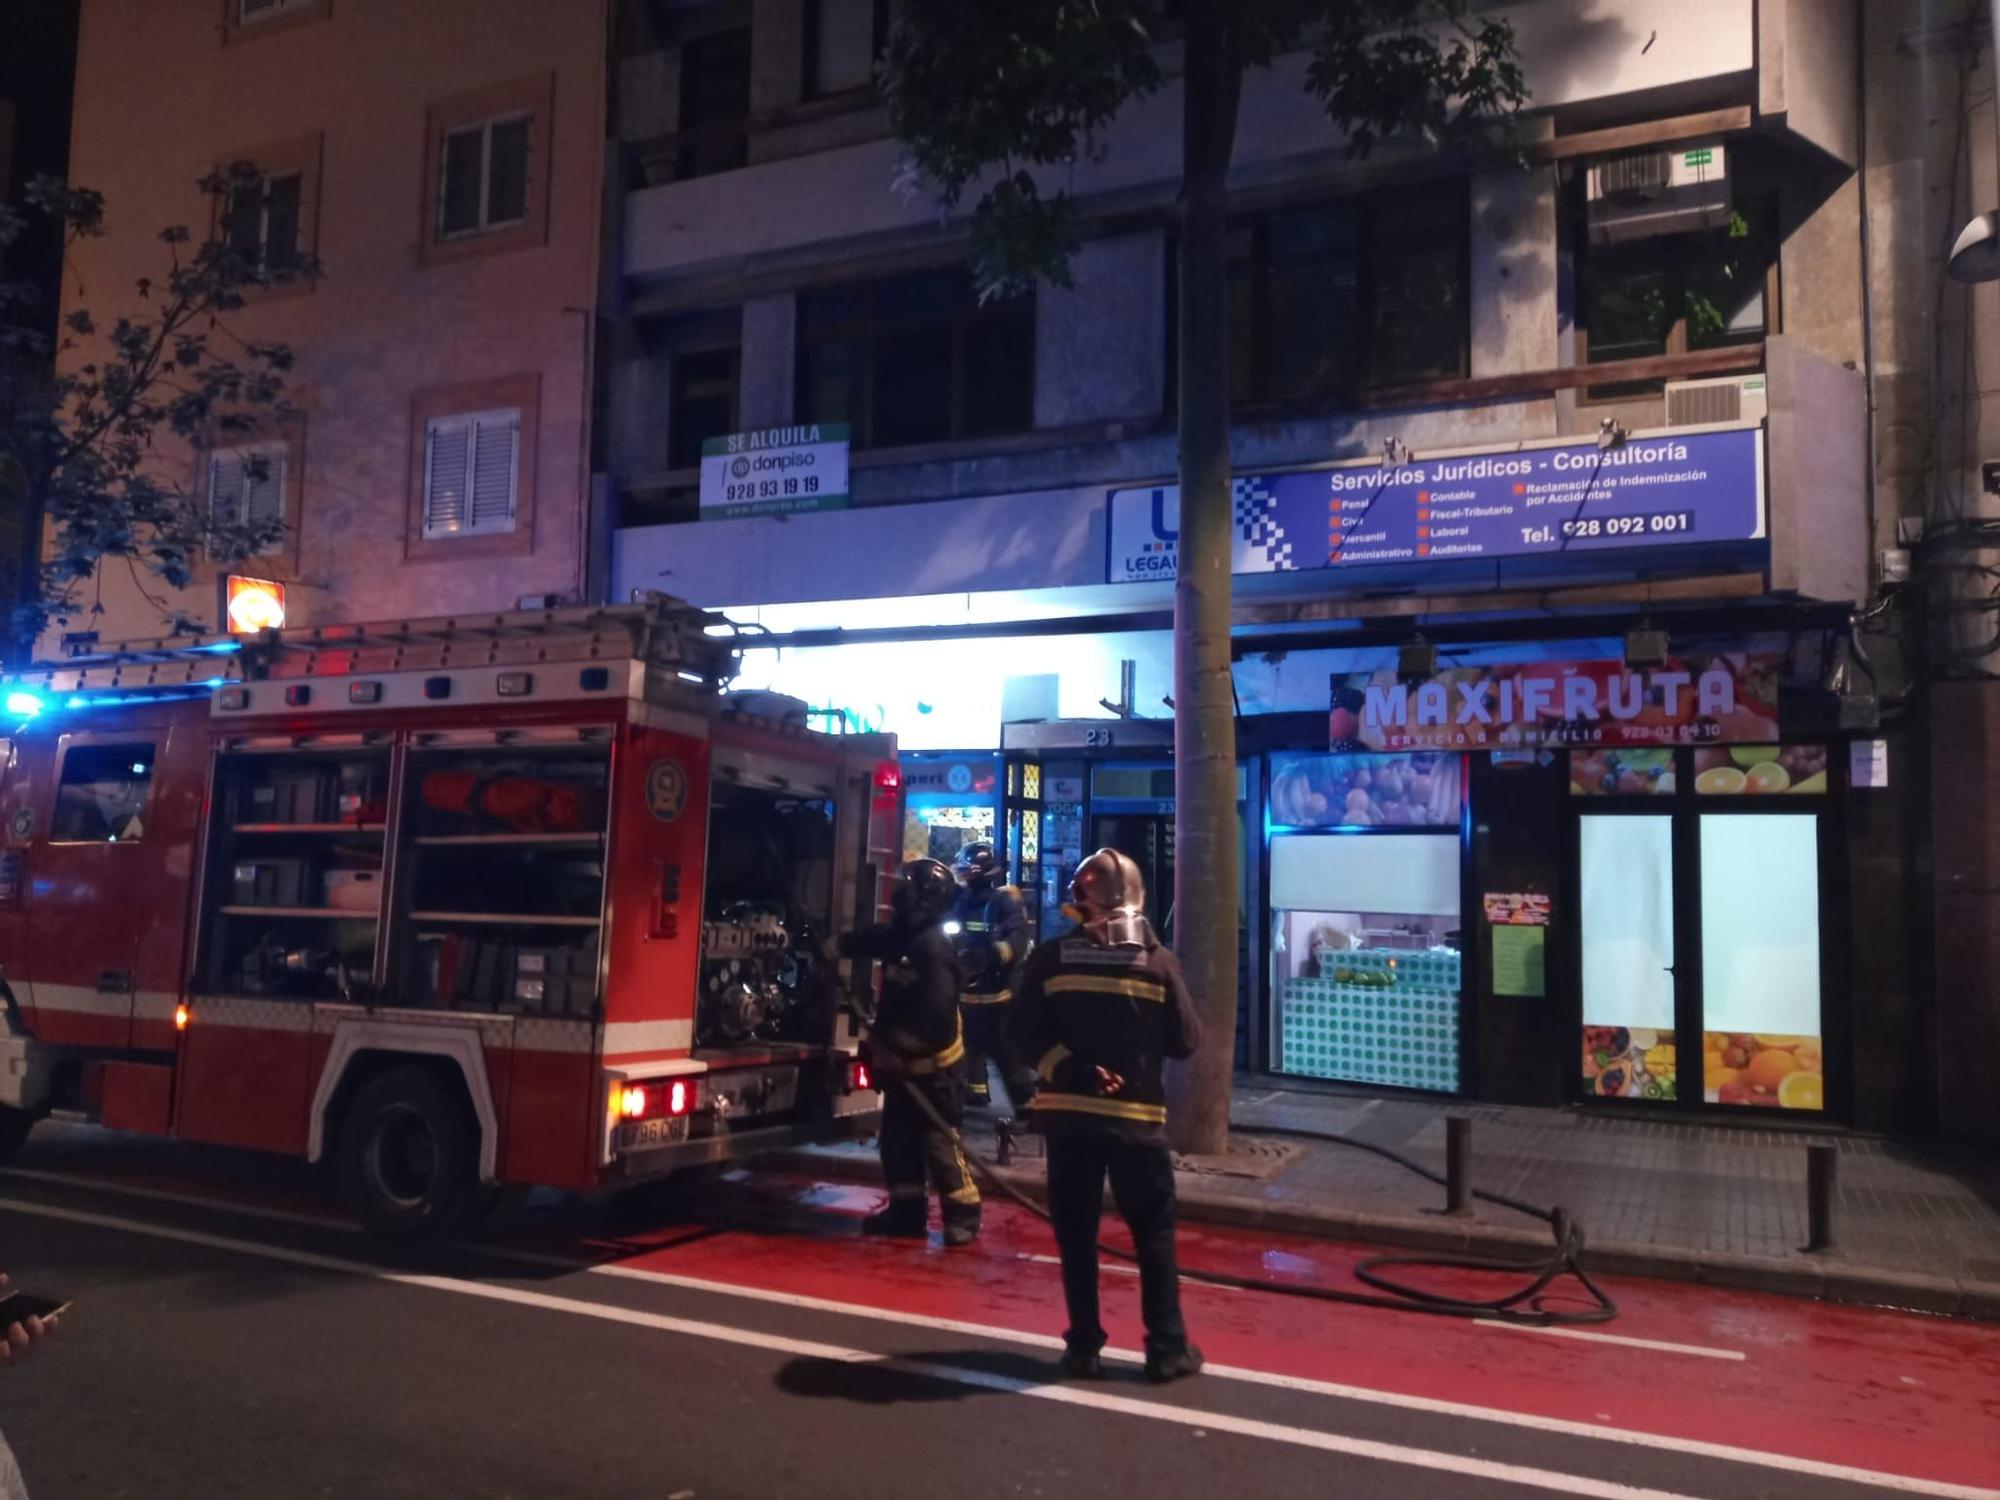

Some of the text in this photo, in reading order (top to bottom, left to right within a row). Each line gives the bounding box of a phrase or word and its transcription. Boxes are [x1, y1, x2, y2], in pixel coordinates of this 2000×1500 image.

[728, 425, 820, 453] SE ALQUILA
[752, 452, 815, 472] donpiso
[1330, 467, 1425, 492] Servicios
[1432, 459, 1532, 482] Jurídicos
[1553, 442, 1688, 471] Consultoría
[1602, 475, 1618, 488] de
[1620, 469, 1707, 487] Indemnización
[727, 476, 819, 500] 928 93 19 19
[1342, 498, 1370, 510] Penal
[1430, 491, 1476, 503] Contable
[1526, 495, 1546, 507] por
[1430, 505, 1514, 521] Fiscal-Tributario
[1430, 527, 1469, 539] Laboral
[1563, 513, 1688, 538] 928 092 001
[1521, 526, 1555, 543] Tel.
[1341, 549, 1413, 563] Administrativo
[1364, 669, 1735, 728] MAXIFRUTA
[1086, 728, 1110, 747] 23
[1703, 724, 1721, 737] 10
[906, 771, 944, 787] pert
